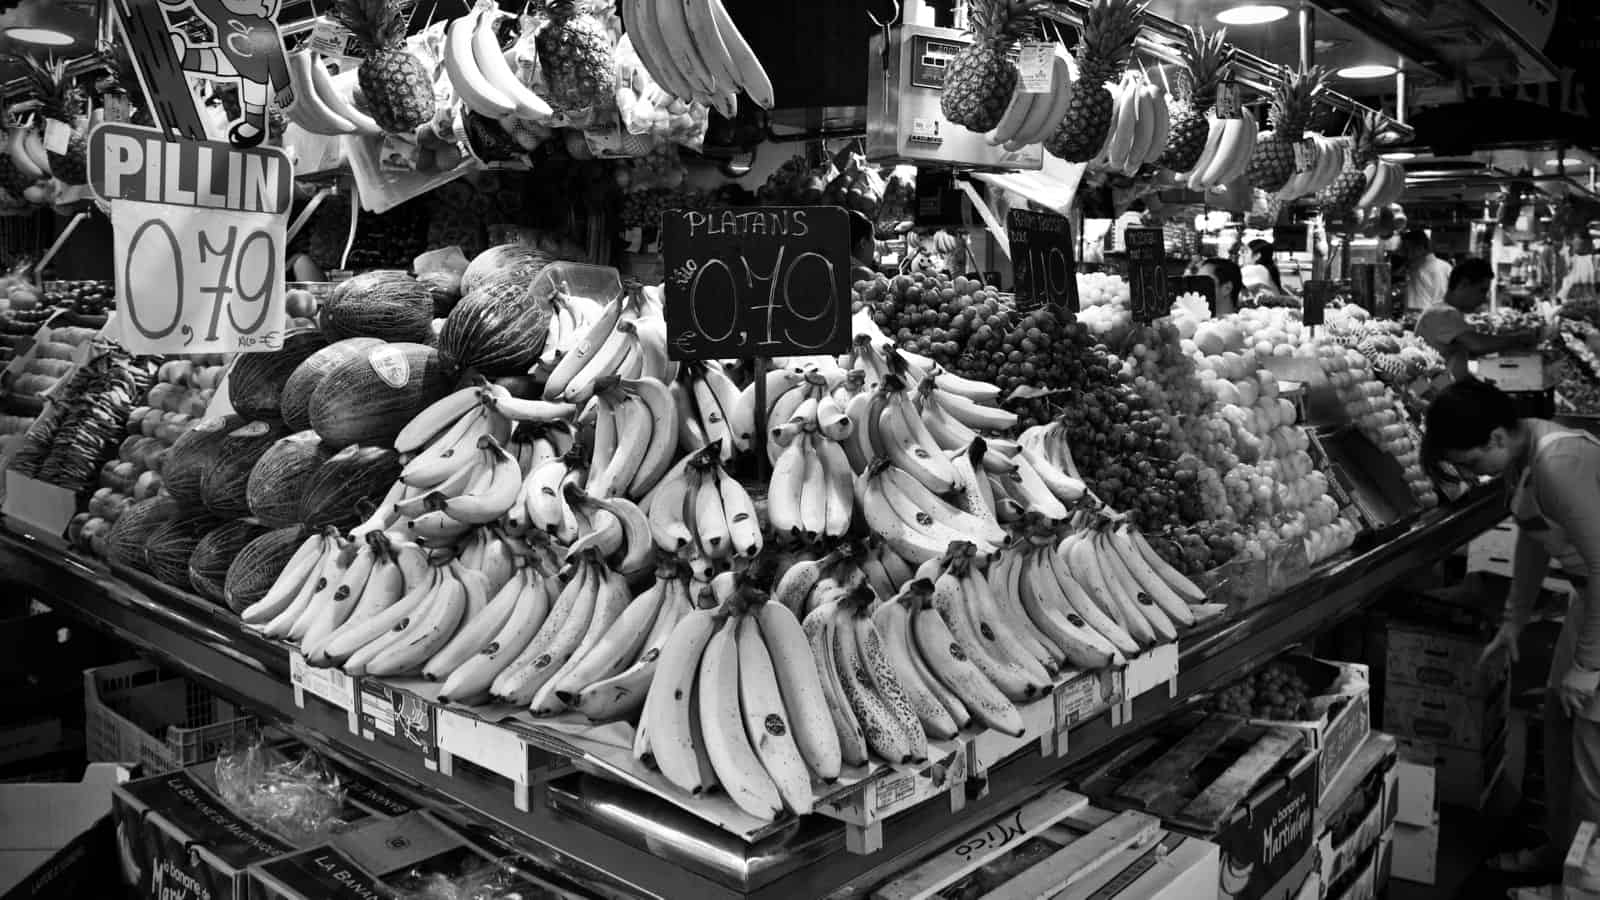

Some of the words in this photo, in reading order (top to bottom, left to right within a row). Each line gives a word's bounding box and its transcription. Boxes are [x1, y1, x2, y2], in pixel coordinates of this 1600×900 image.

[103, 132, 280, 214] PILLIN
[682, 209, 809, 238] PLATANS
[125, 218, 276, 347] 0,79
[690, 245, 839, 350] 0,79
[314, 855, 337, 873] LA
